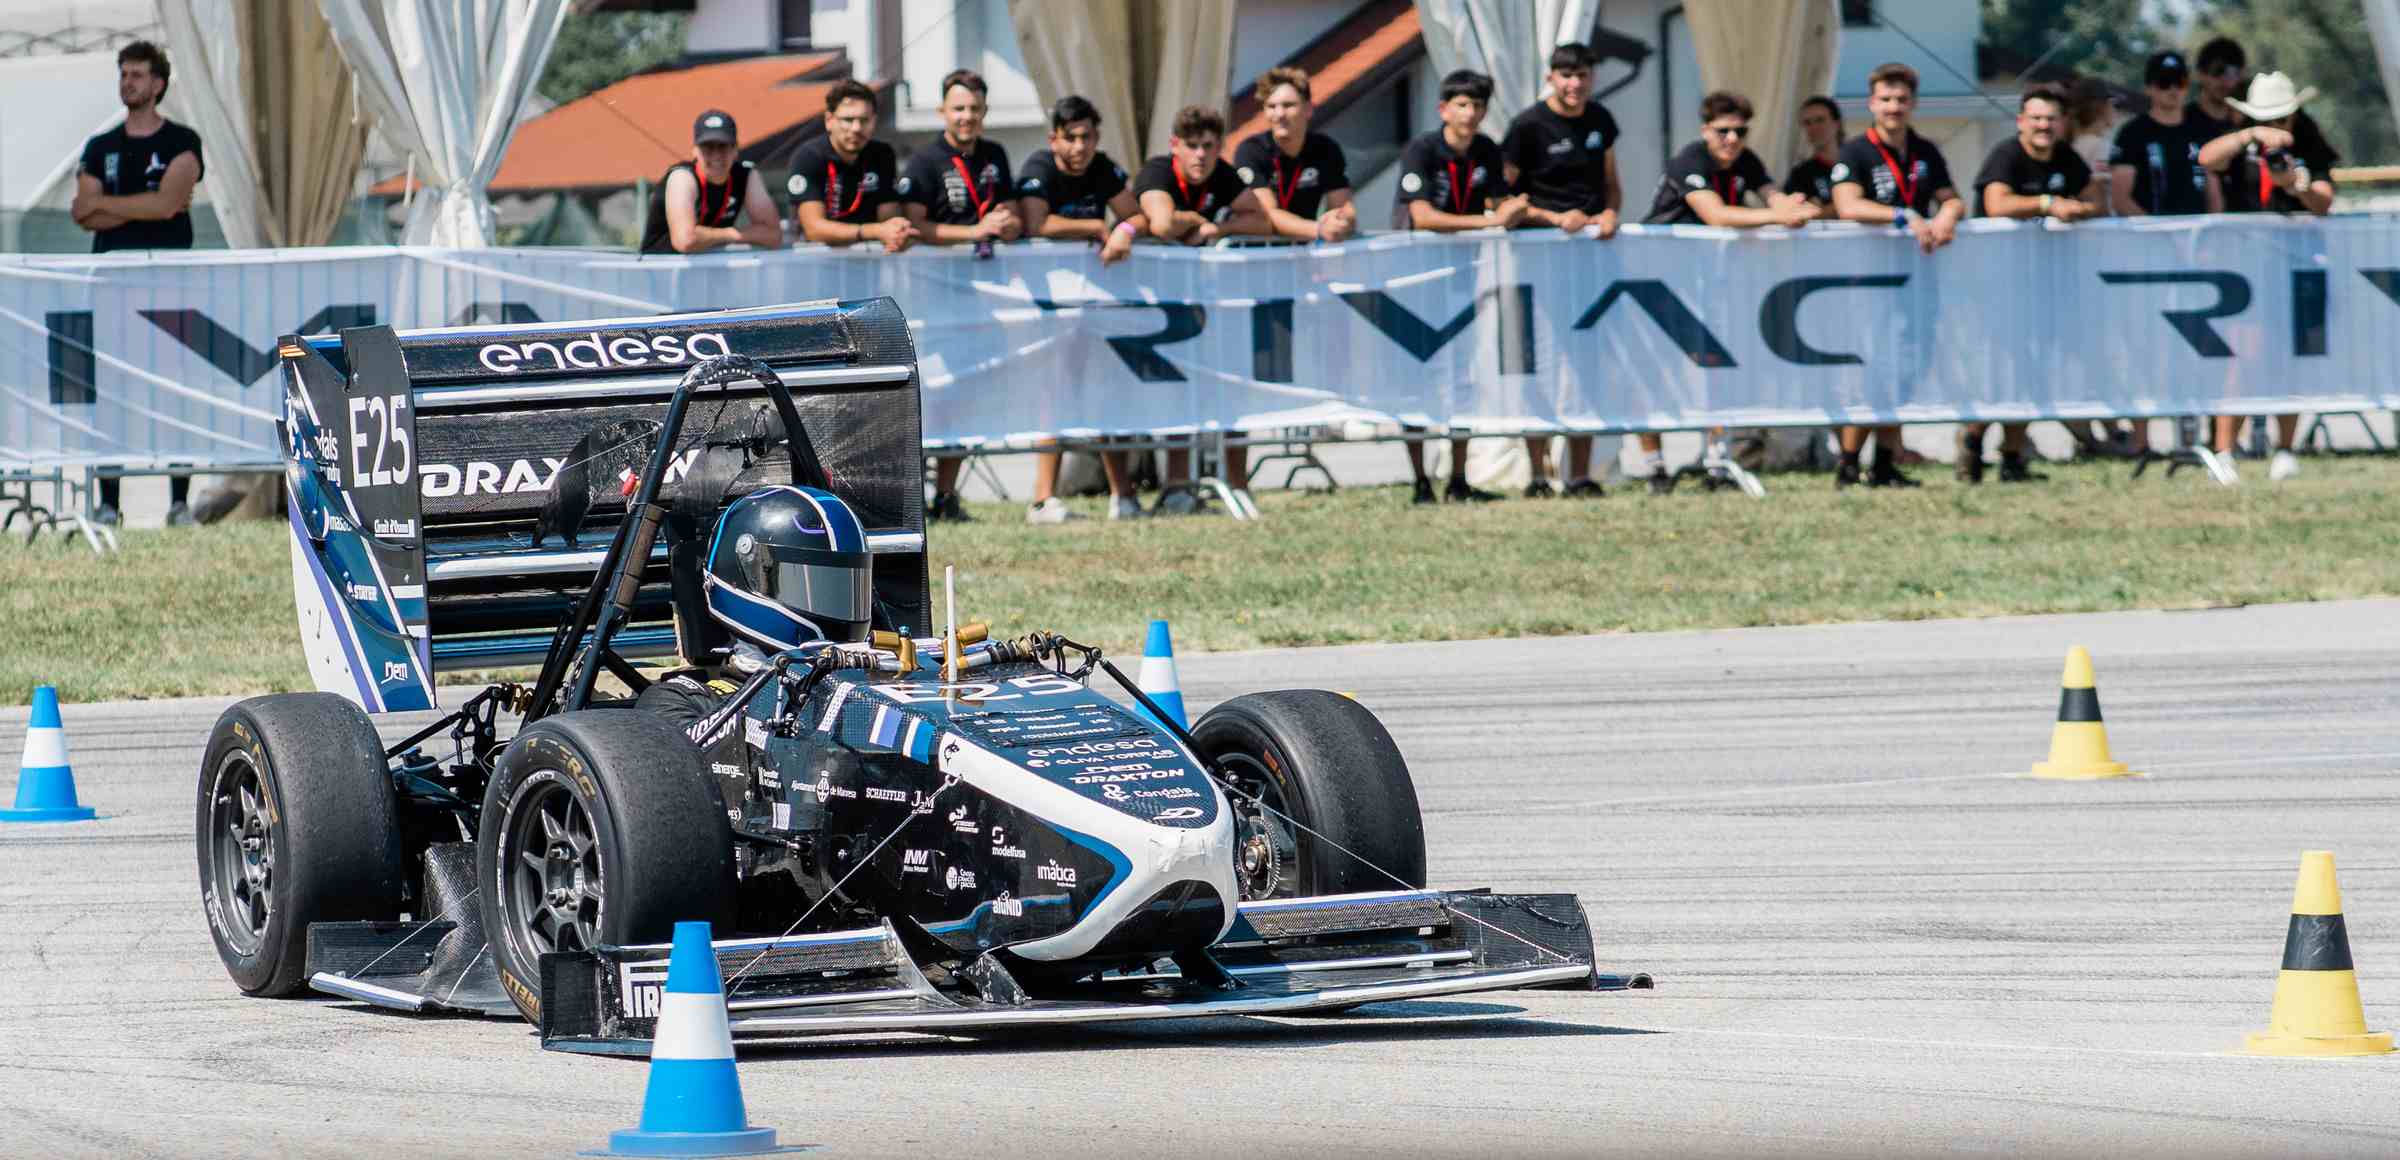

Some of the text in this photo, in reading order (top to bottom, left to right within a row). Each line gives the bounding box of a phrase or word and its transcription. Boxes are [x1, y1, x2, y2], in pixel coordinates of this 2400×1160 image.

[1032, 272, 1910, 383] RIMAC
[479, 332, 733, 373] endesa
[348, 394, 411, 489] E25
[419, 447, 700, 498] DRAXN
[870, 672, 1084, 704] E25
[1026, 738, 1159, 758] endesa
[1068, 767, 1185, 785] DRAXTON
[865, 787, 906, 802] SCHAEFFLER
[904, 849, 929, 865] INM
